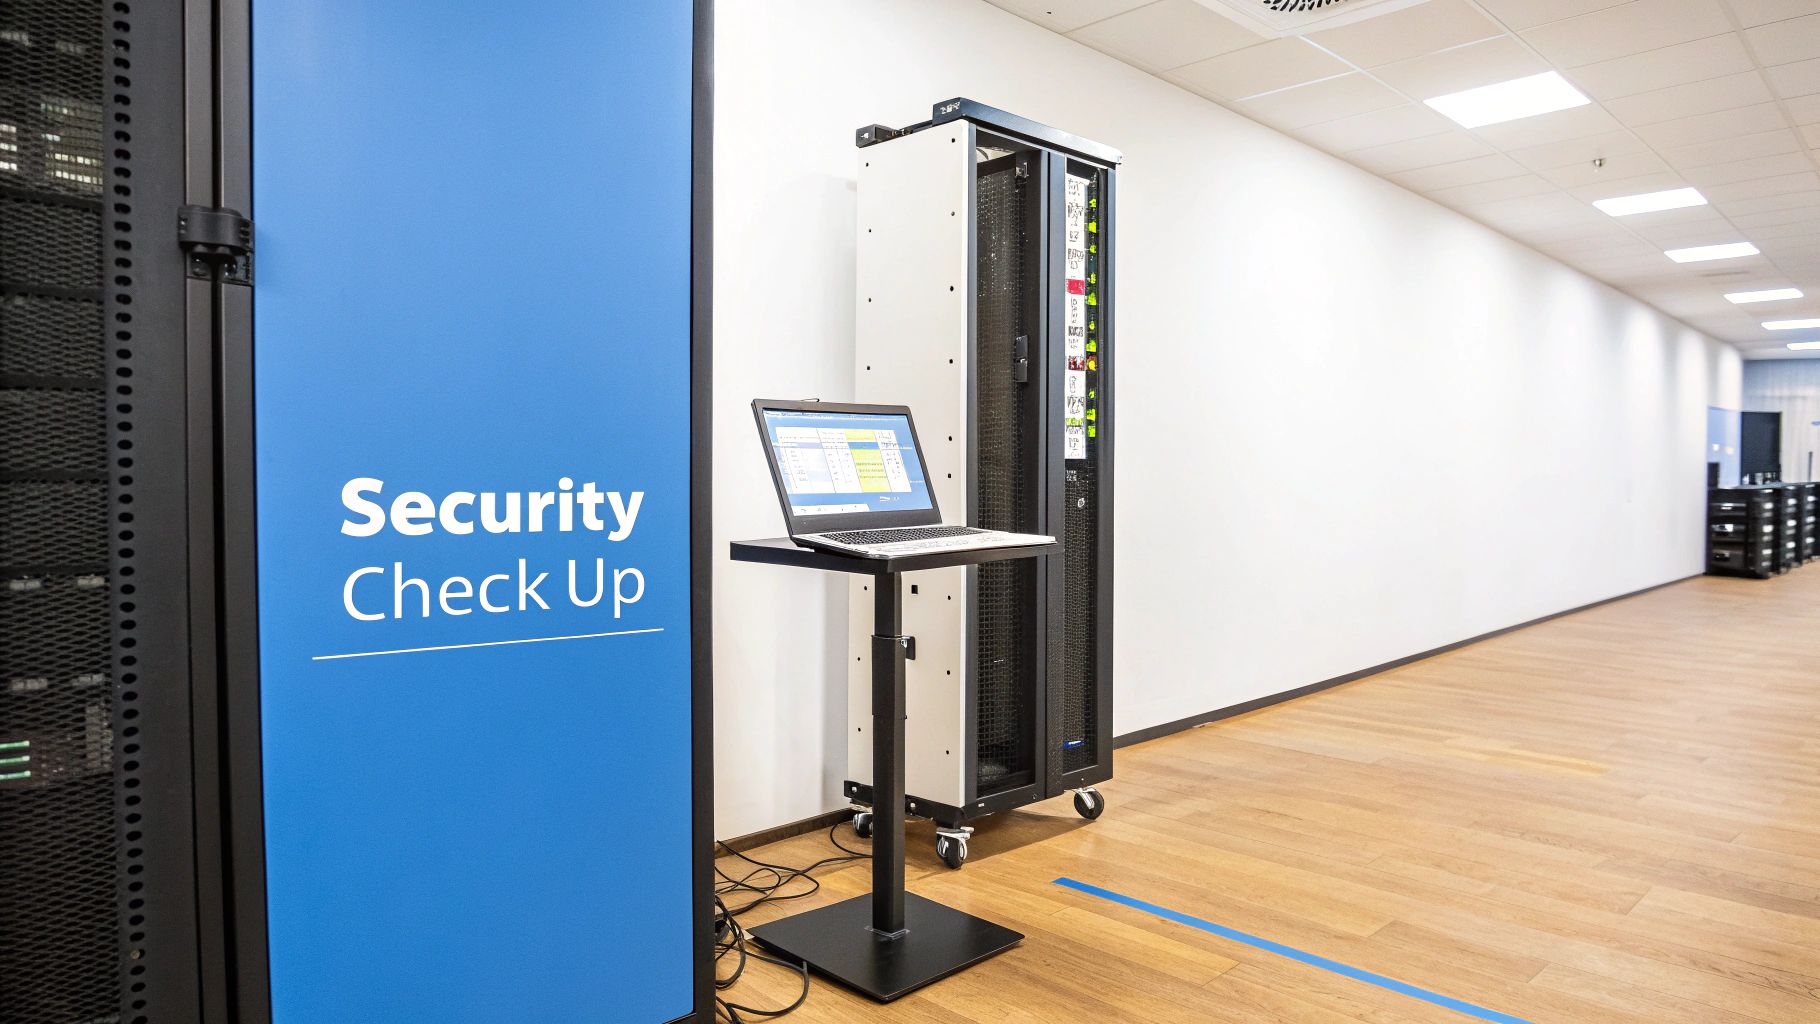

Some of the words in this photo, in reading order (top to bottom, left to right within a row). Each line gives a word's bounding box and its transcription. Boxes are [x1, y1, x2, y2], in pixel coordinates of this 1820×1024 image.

[341, 477, 645, 541] Security
[343, 559, 551, 621] Check
[568, 558, 645, 618] Up
